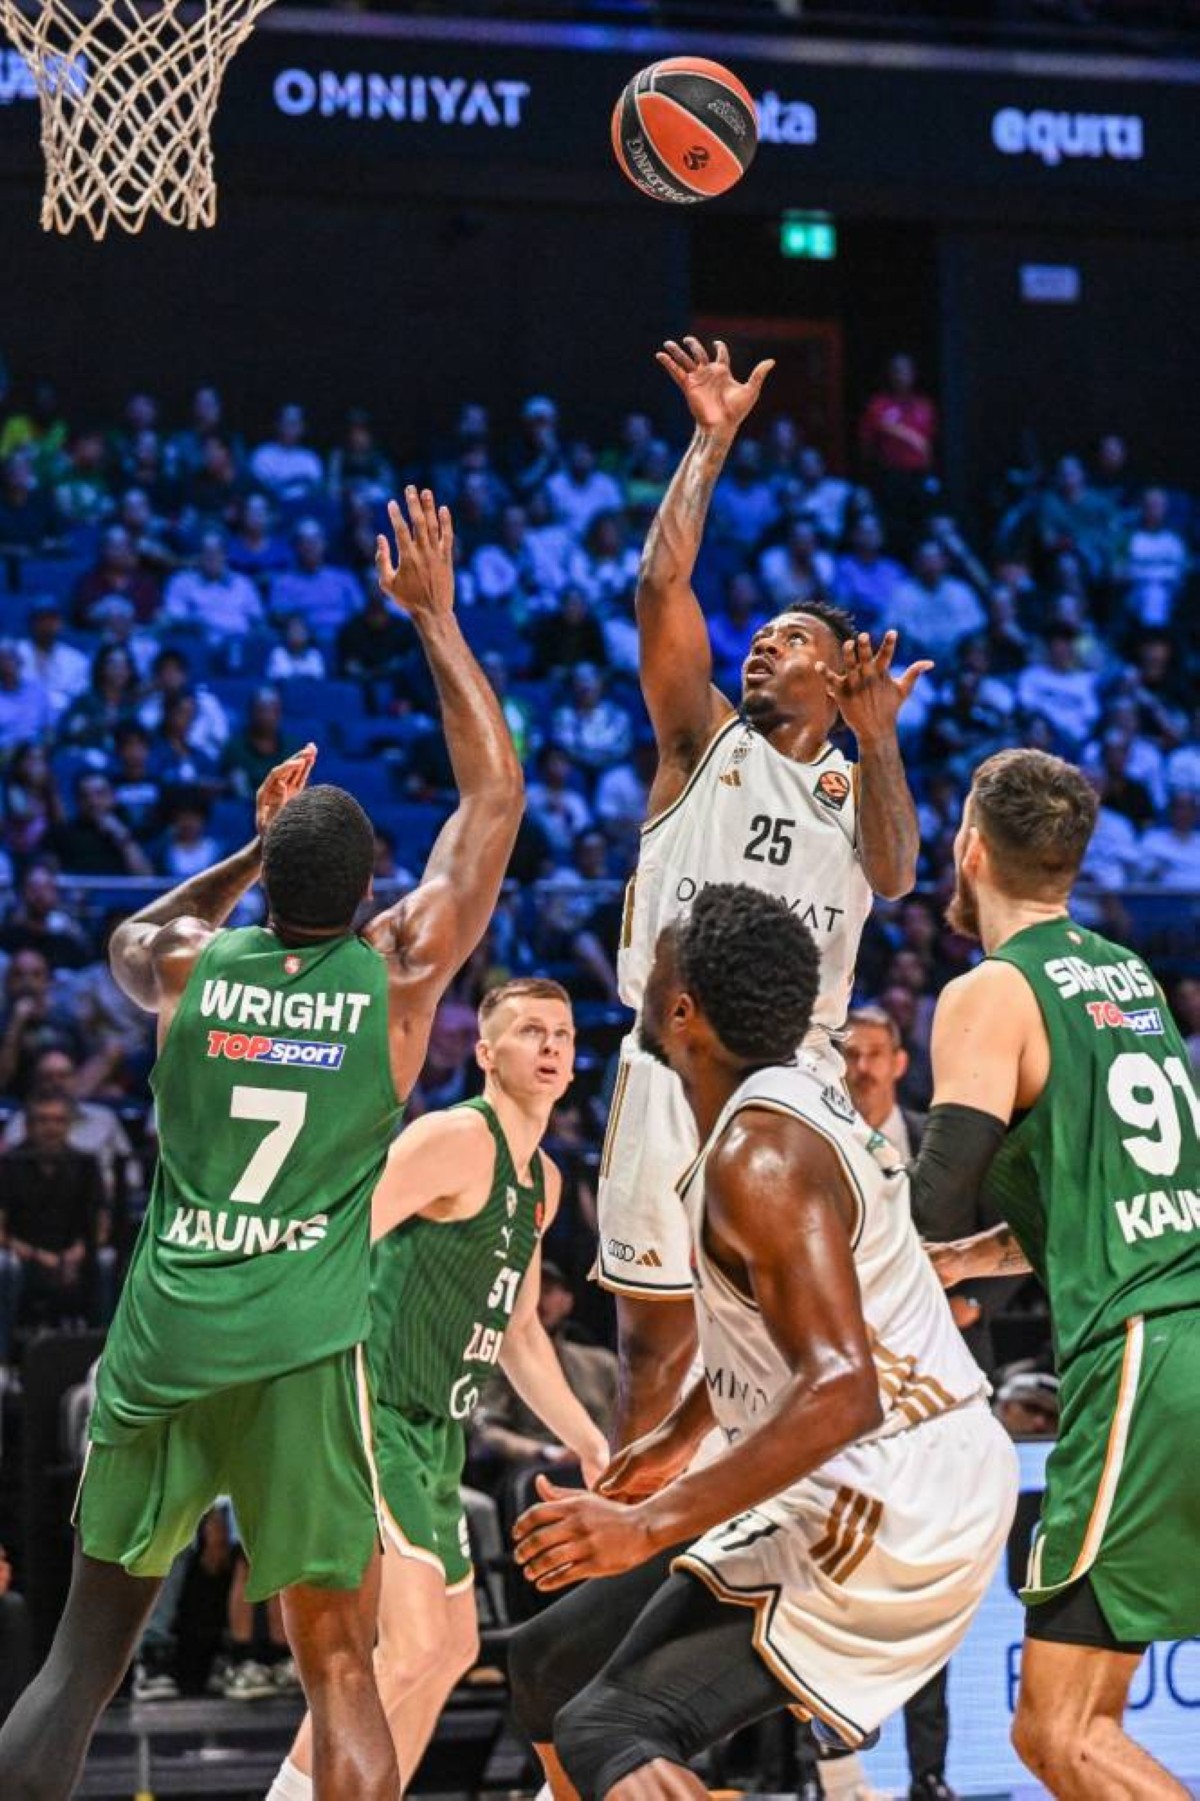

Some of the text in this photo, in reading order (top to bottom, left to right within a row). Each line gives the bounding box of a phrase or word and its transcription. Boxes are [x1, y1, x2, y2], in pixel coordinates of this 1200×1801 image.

[273, 69, 531, 128] OMNIYAT
[757, 91, 817, 144] ta
[743, 815, 796, 866] 25
[200, 979, 371, 1034] WRIGHT
[1107, 1052, 1200, 1177] 91
[229, 1085, 308, 1205] 7
[165, 1206, 330, 1255] KAUNAS
[487, 1267, 522, 1315] 51
